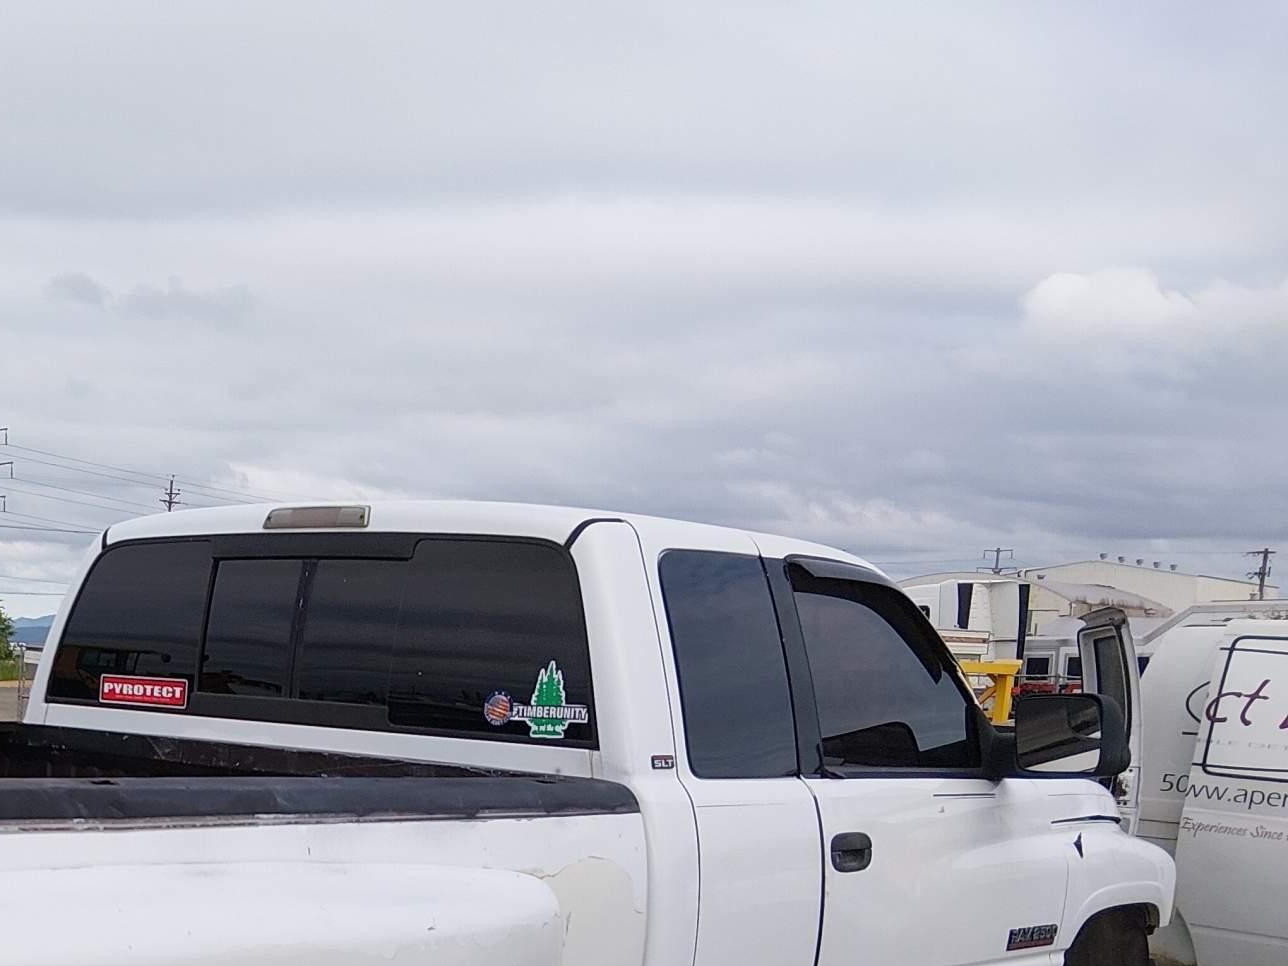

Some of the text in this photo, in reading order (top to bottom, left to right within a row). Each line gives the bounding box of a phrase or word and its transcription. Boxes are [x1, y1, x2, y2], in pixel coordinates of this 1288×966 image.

[103, 682, 184, 699] PYROTECT
[653, 759, 673, 768] SLT
[1181, 816, 1284, 841] Experiences Since
